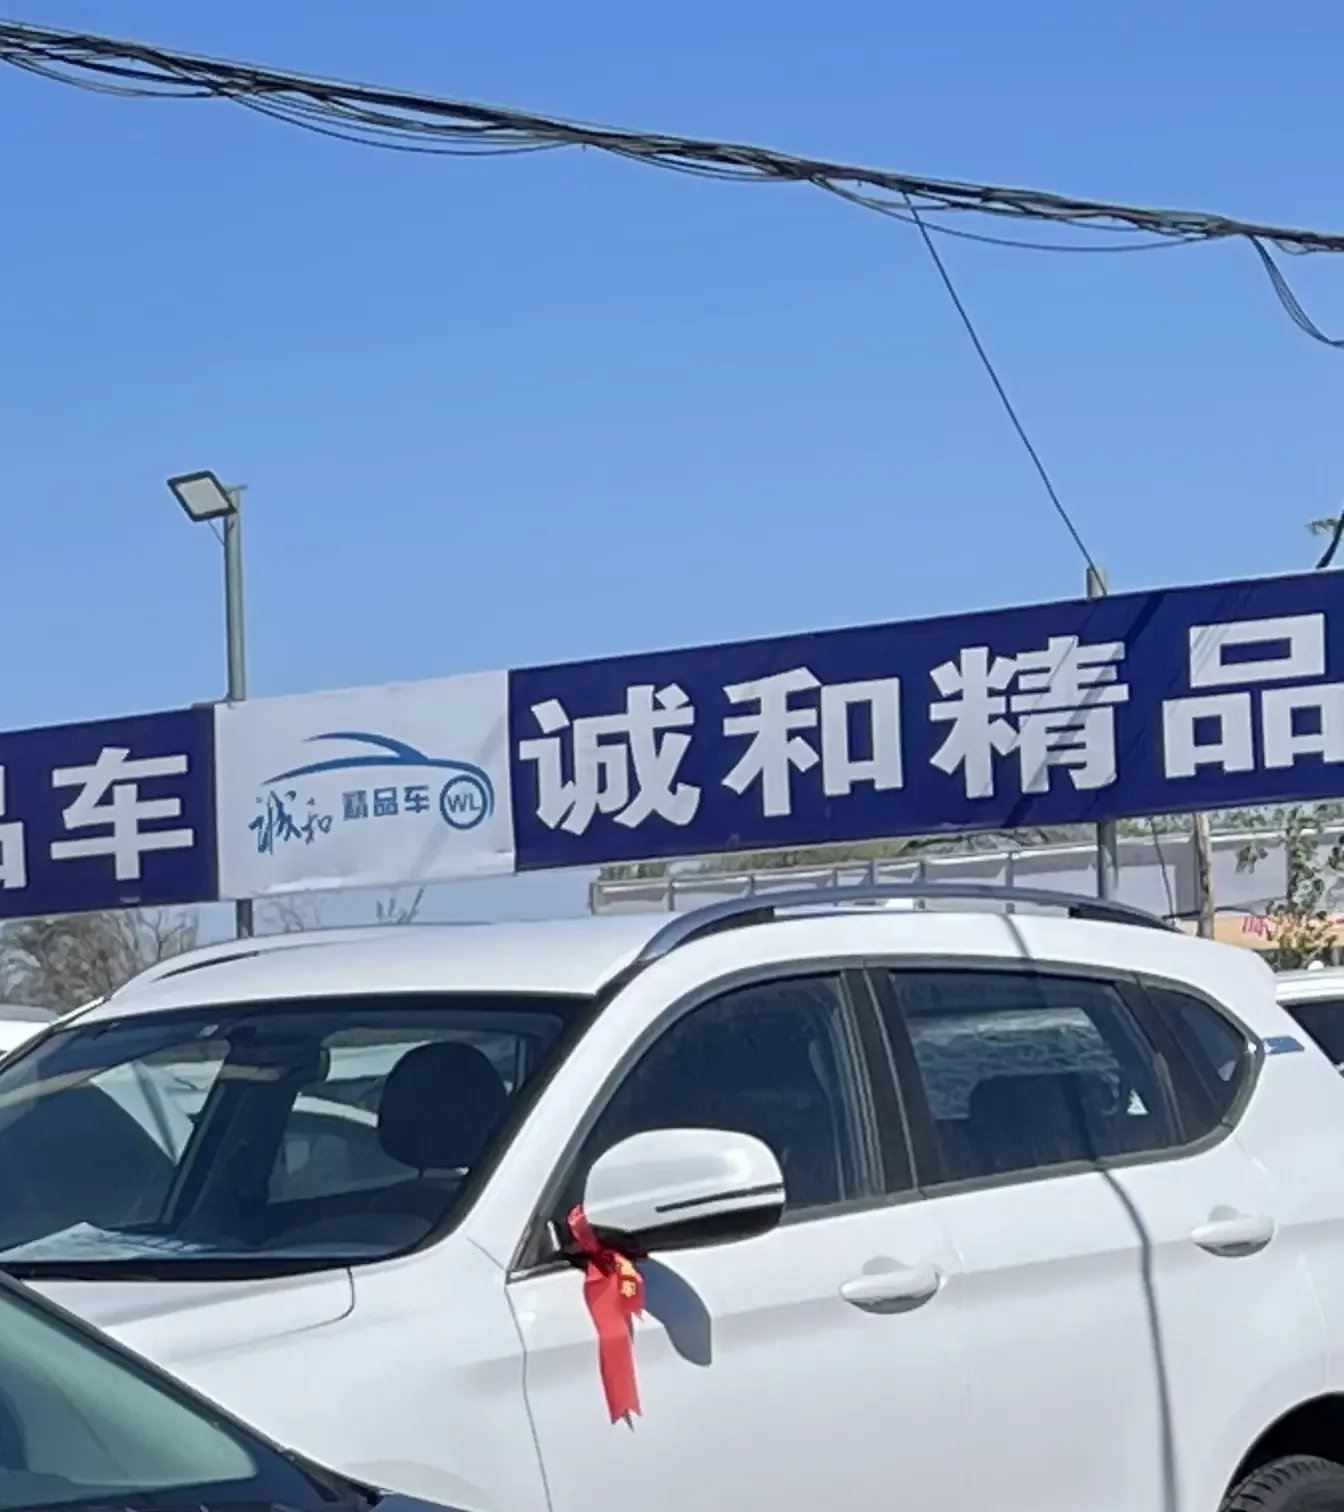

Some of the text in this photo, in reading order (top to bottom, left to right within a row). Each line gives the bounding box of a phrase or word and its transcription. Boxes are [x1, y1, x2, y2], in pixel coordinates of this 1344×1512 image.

[519, 613, 1344, 835] 诚和精品
[342, 784, 430, 821] 精品车
[447, 793, 482, 813] WL
